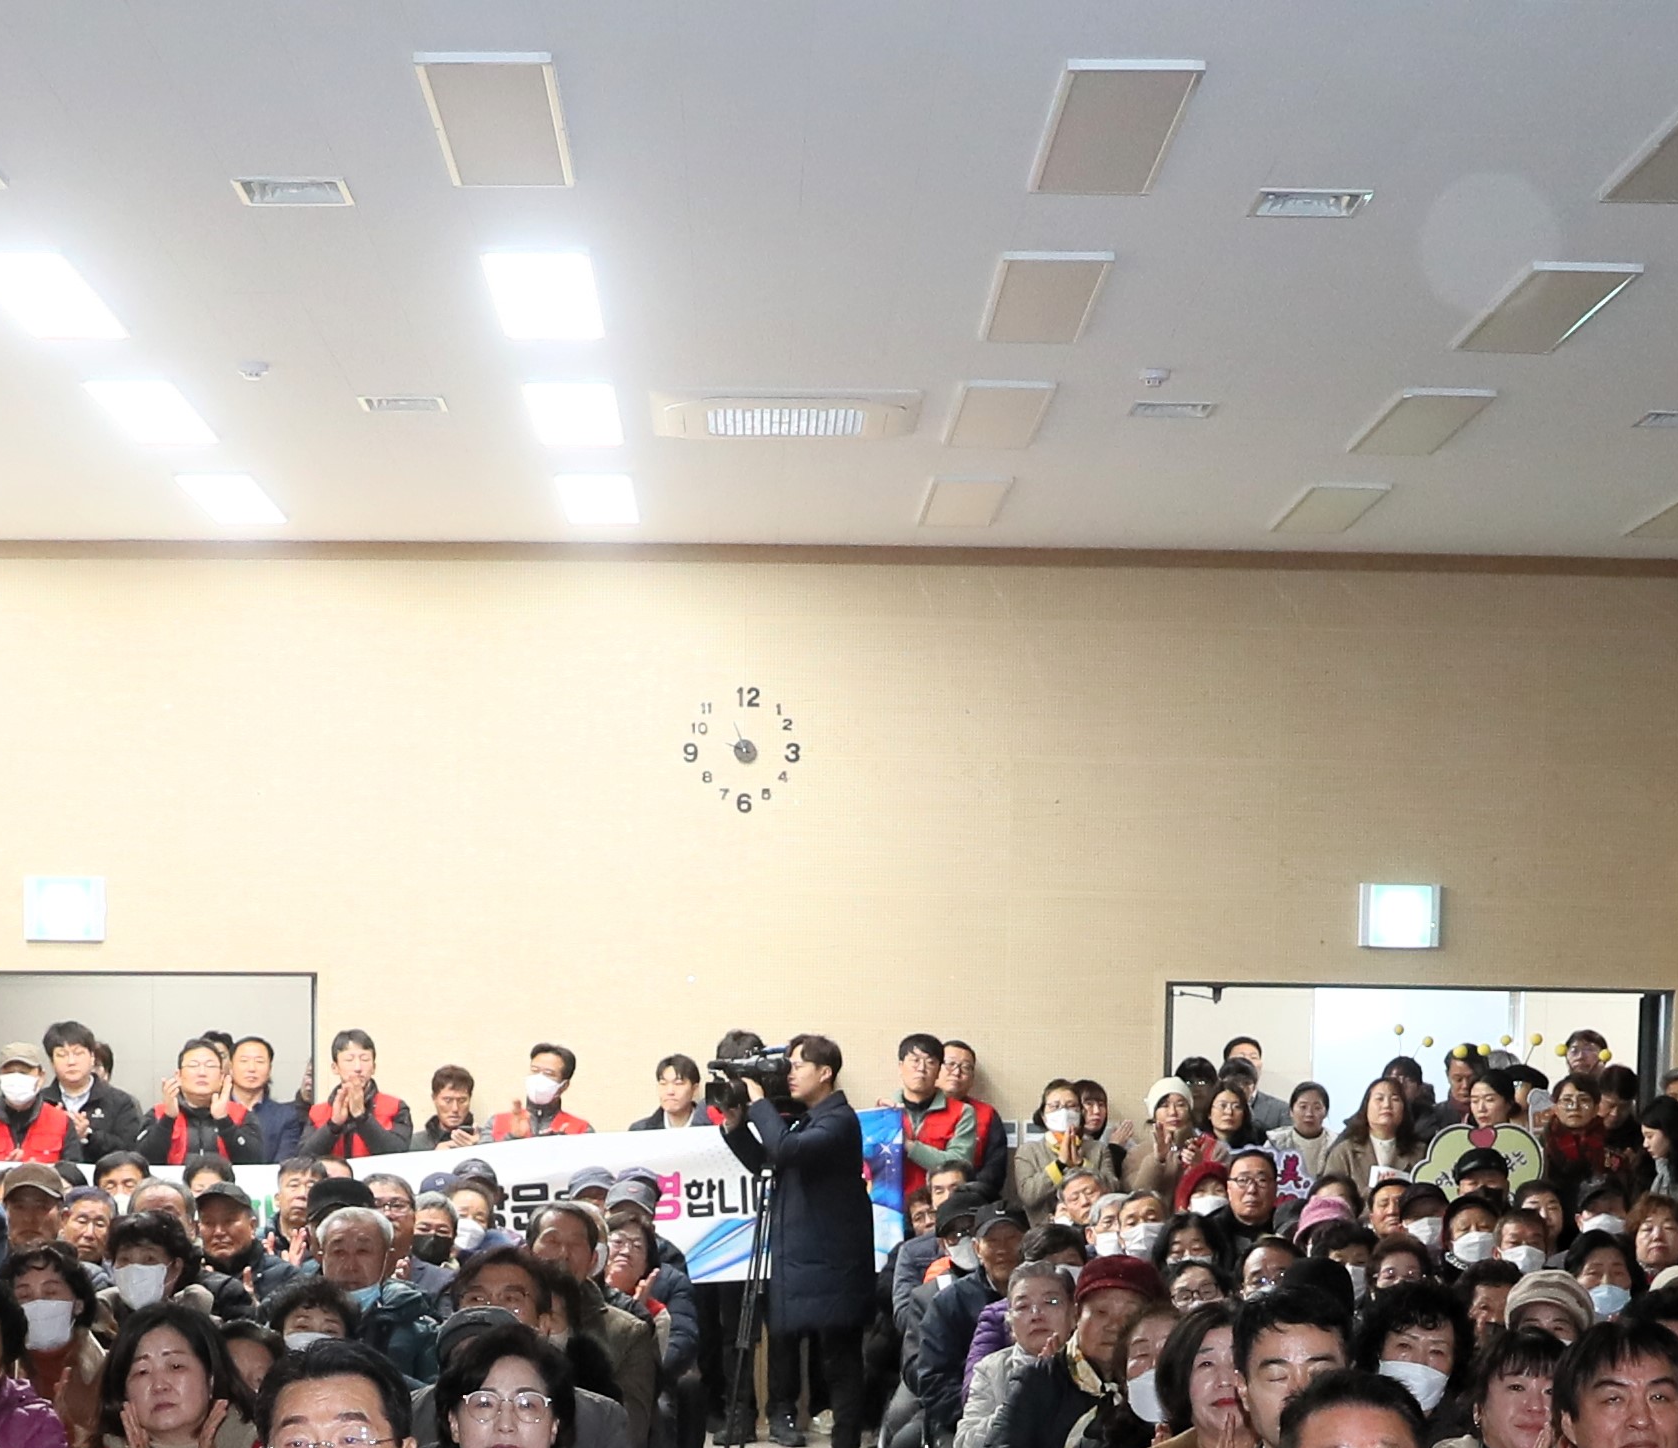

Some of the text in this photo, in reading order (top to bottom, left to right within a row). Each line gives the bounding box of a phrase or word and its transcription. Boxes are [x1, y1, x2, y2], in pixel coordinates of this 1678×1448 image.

[736, 686, 760, 708] 12
[701, 702, 712, 714] 11
[776, 703, 782, 716] 1
[691, 722, 708, 735] 10
[782, 718, 793, 731] 2
[683, 743, 698, 763] 9
[784, 743, 801, 763] 3
[702, 771, 712, 783] 8
[777, 771, 788, 783] 4
[719, 788, 730, 800] 7
[761, 788, 771, 801] 5
[736, 793, 752, 813] 6
